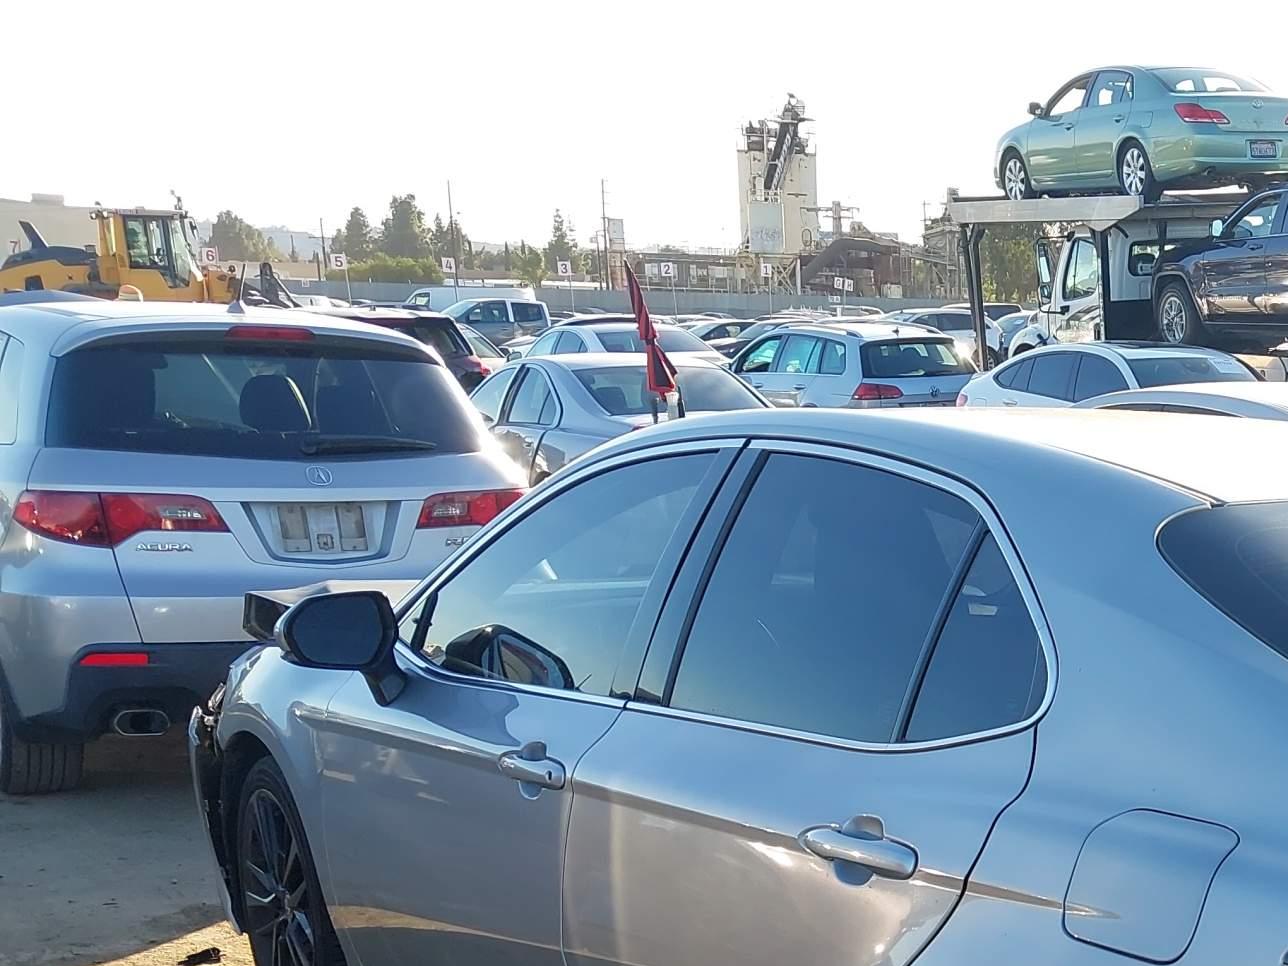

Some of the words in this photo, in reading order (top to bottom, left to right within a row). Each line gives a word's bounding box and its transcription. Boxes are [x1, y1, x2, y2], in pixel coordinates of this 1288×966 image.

[206, 249, 215, 262] 6
[334, 255, 344, 268] 5
[445, 259, 453, 271] 4
[560, 263, 568, 274] 3
[663, 264, 672, 275] 2
[763, 264, 770, 275] 1
[136, 542, 194, 552] ACURA
